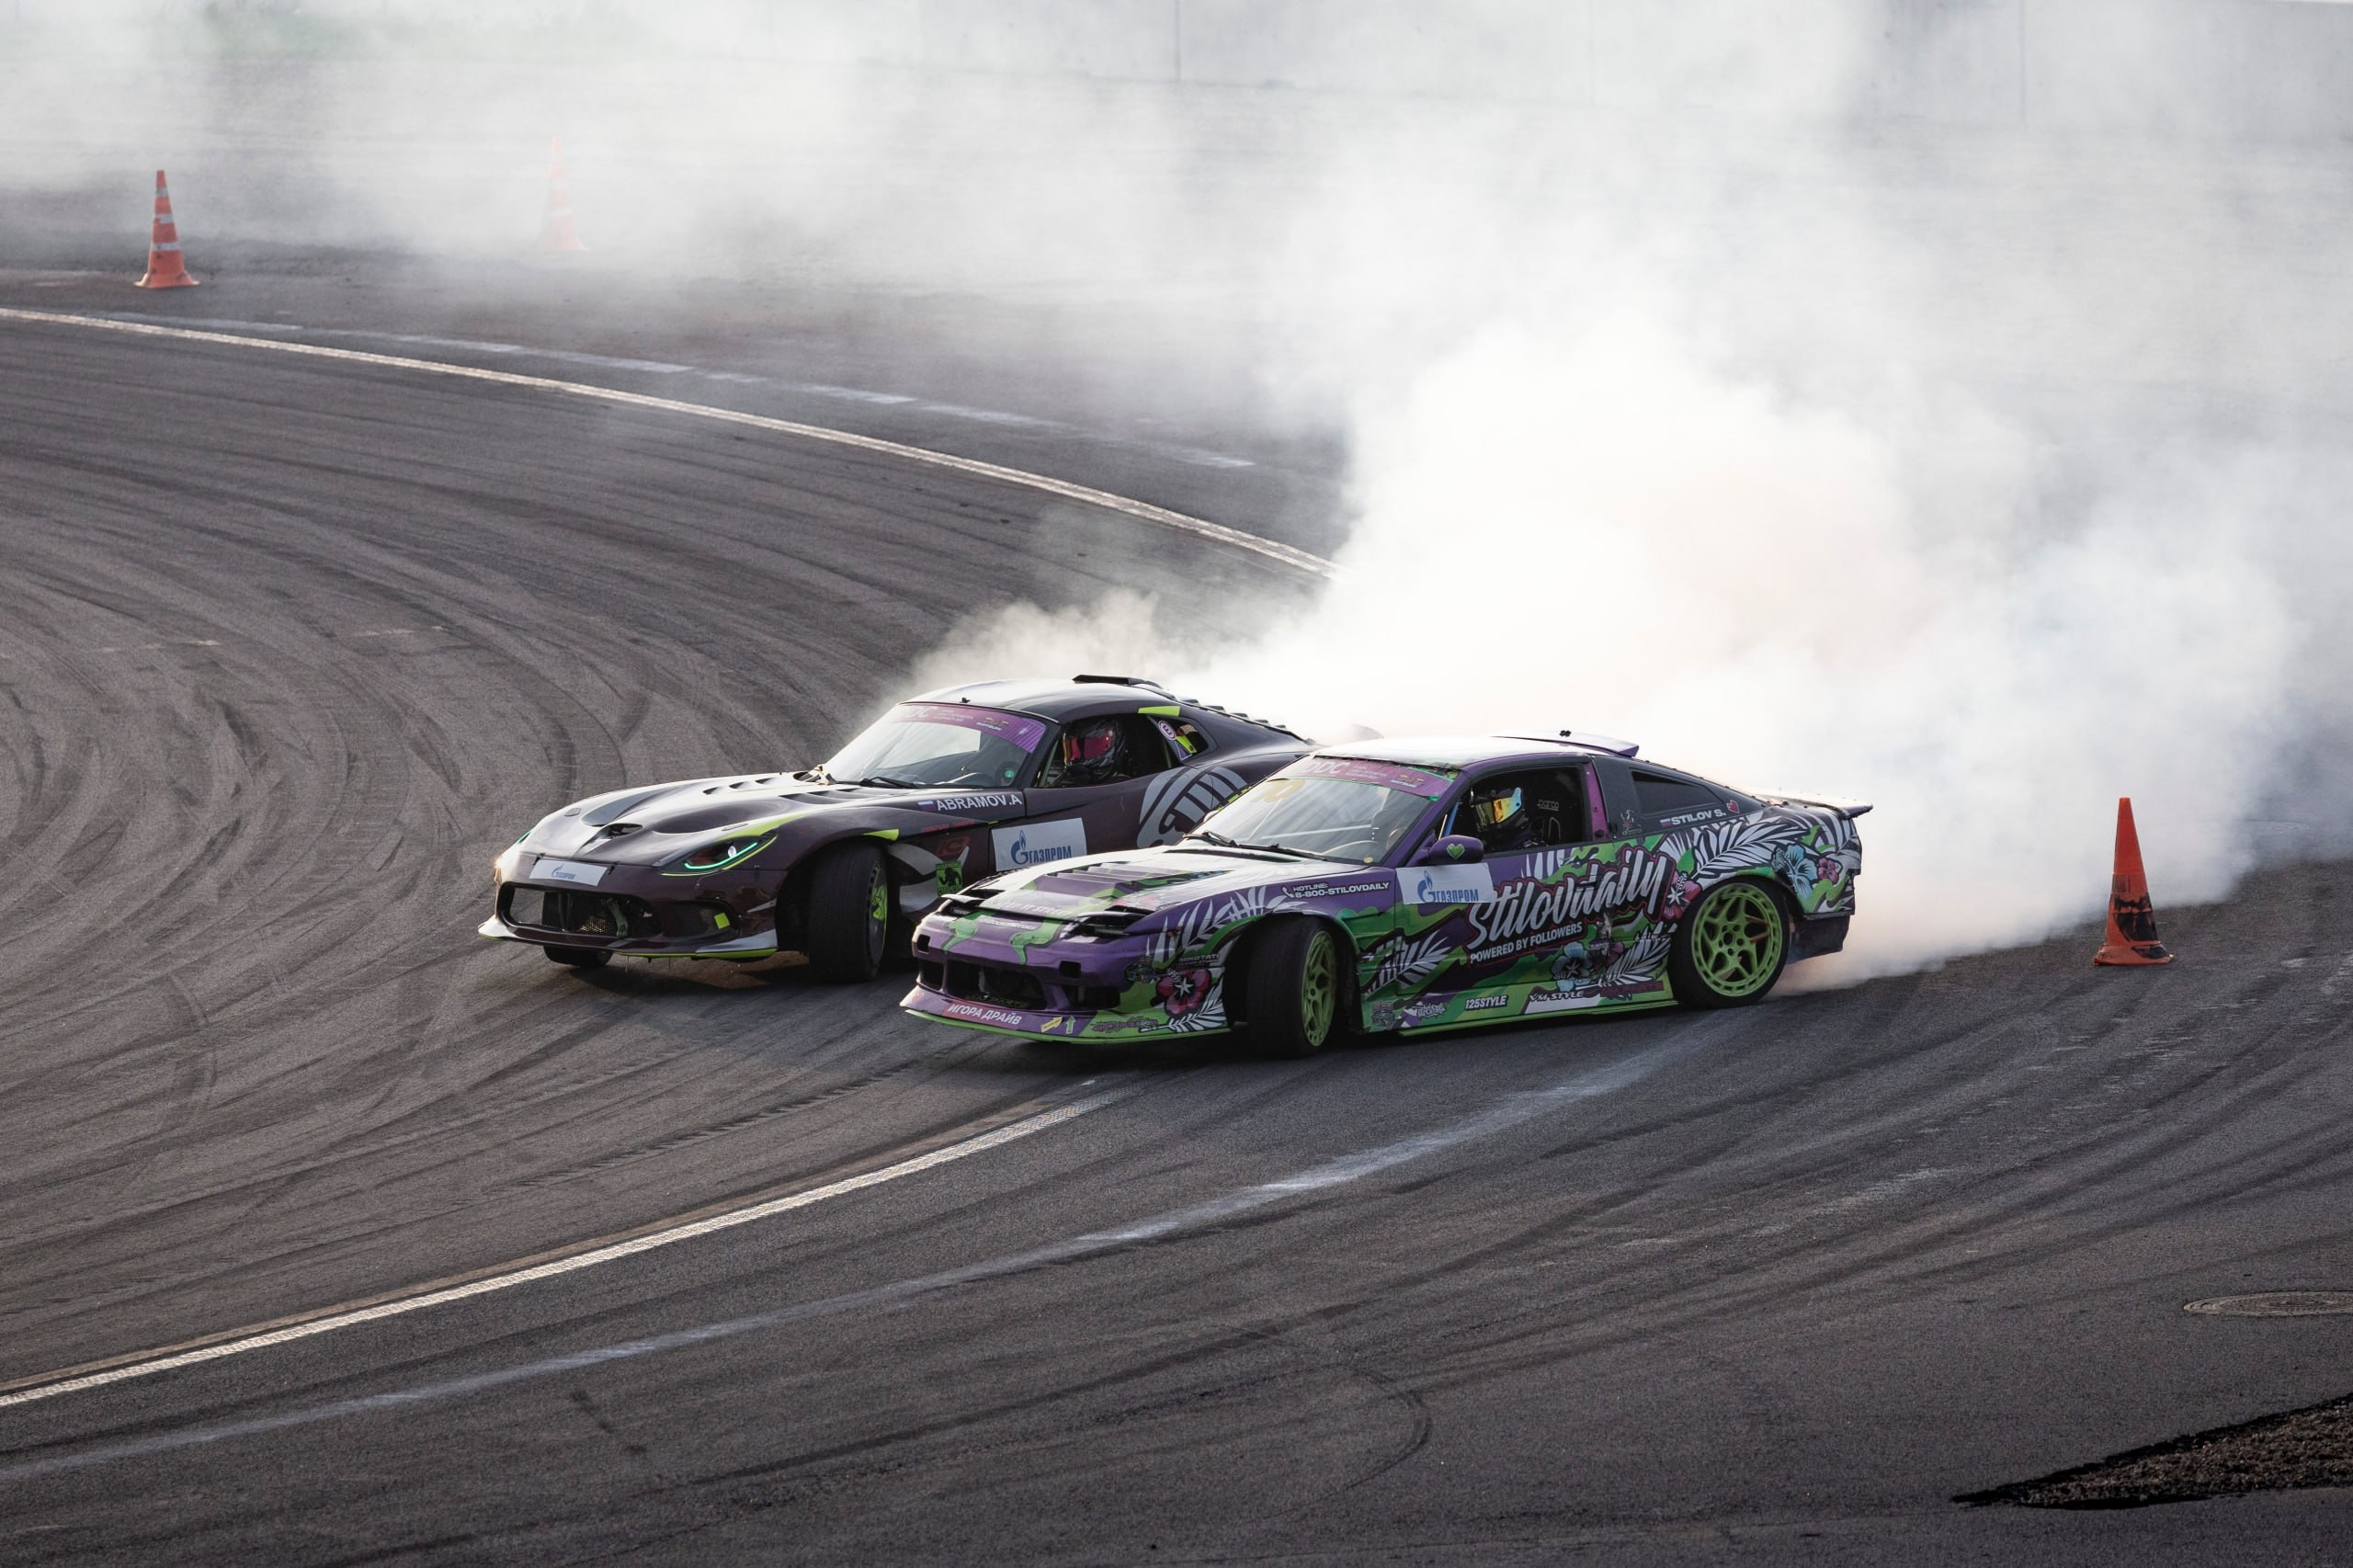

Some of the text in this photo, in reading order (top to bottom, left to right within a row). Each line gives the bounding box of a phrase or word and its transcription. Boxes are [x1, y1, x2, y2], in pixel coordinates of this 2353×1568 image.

[937, 793, 1023, 812] ABRAMOV.A
[1671, 809, 1727, 825] STILOV S.
[1029, 845, 1073, 864] ГАЗПРОМ
[1293, 882, 1329, 892] HOTLINE:
[1294, 881, 1390, 899] 8-800-STILOVDAILY
[1436, 889, 1479, 903] ГАЗПРОМ
[1470, 922, 1583, 964] POWERED BY FOLLOWERS
[1465, 995, 1507, 1009] 125STYLE
[1551, 991, 1585, 1001] STYLE
[947, 1004, 1023, 1026] ИГОРА ДРАЙВ
